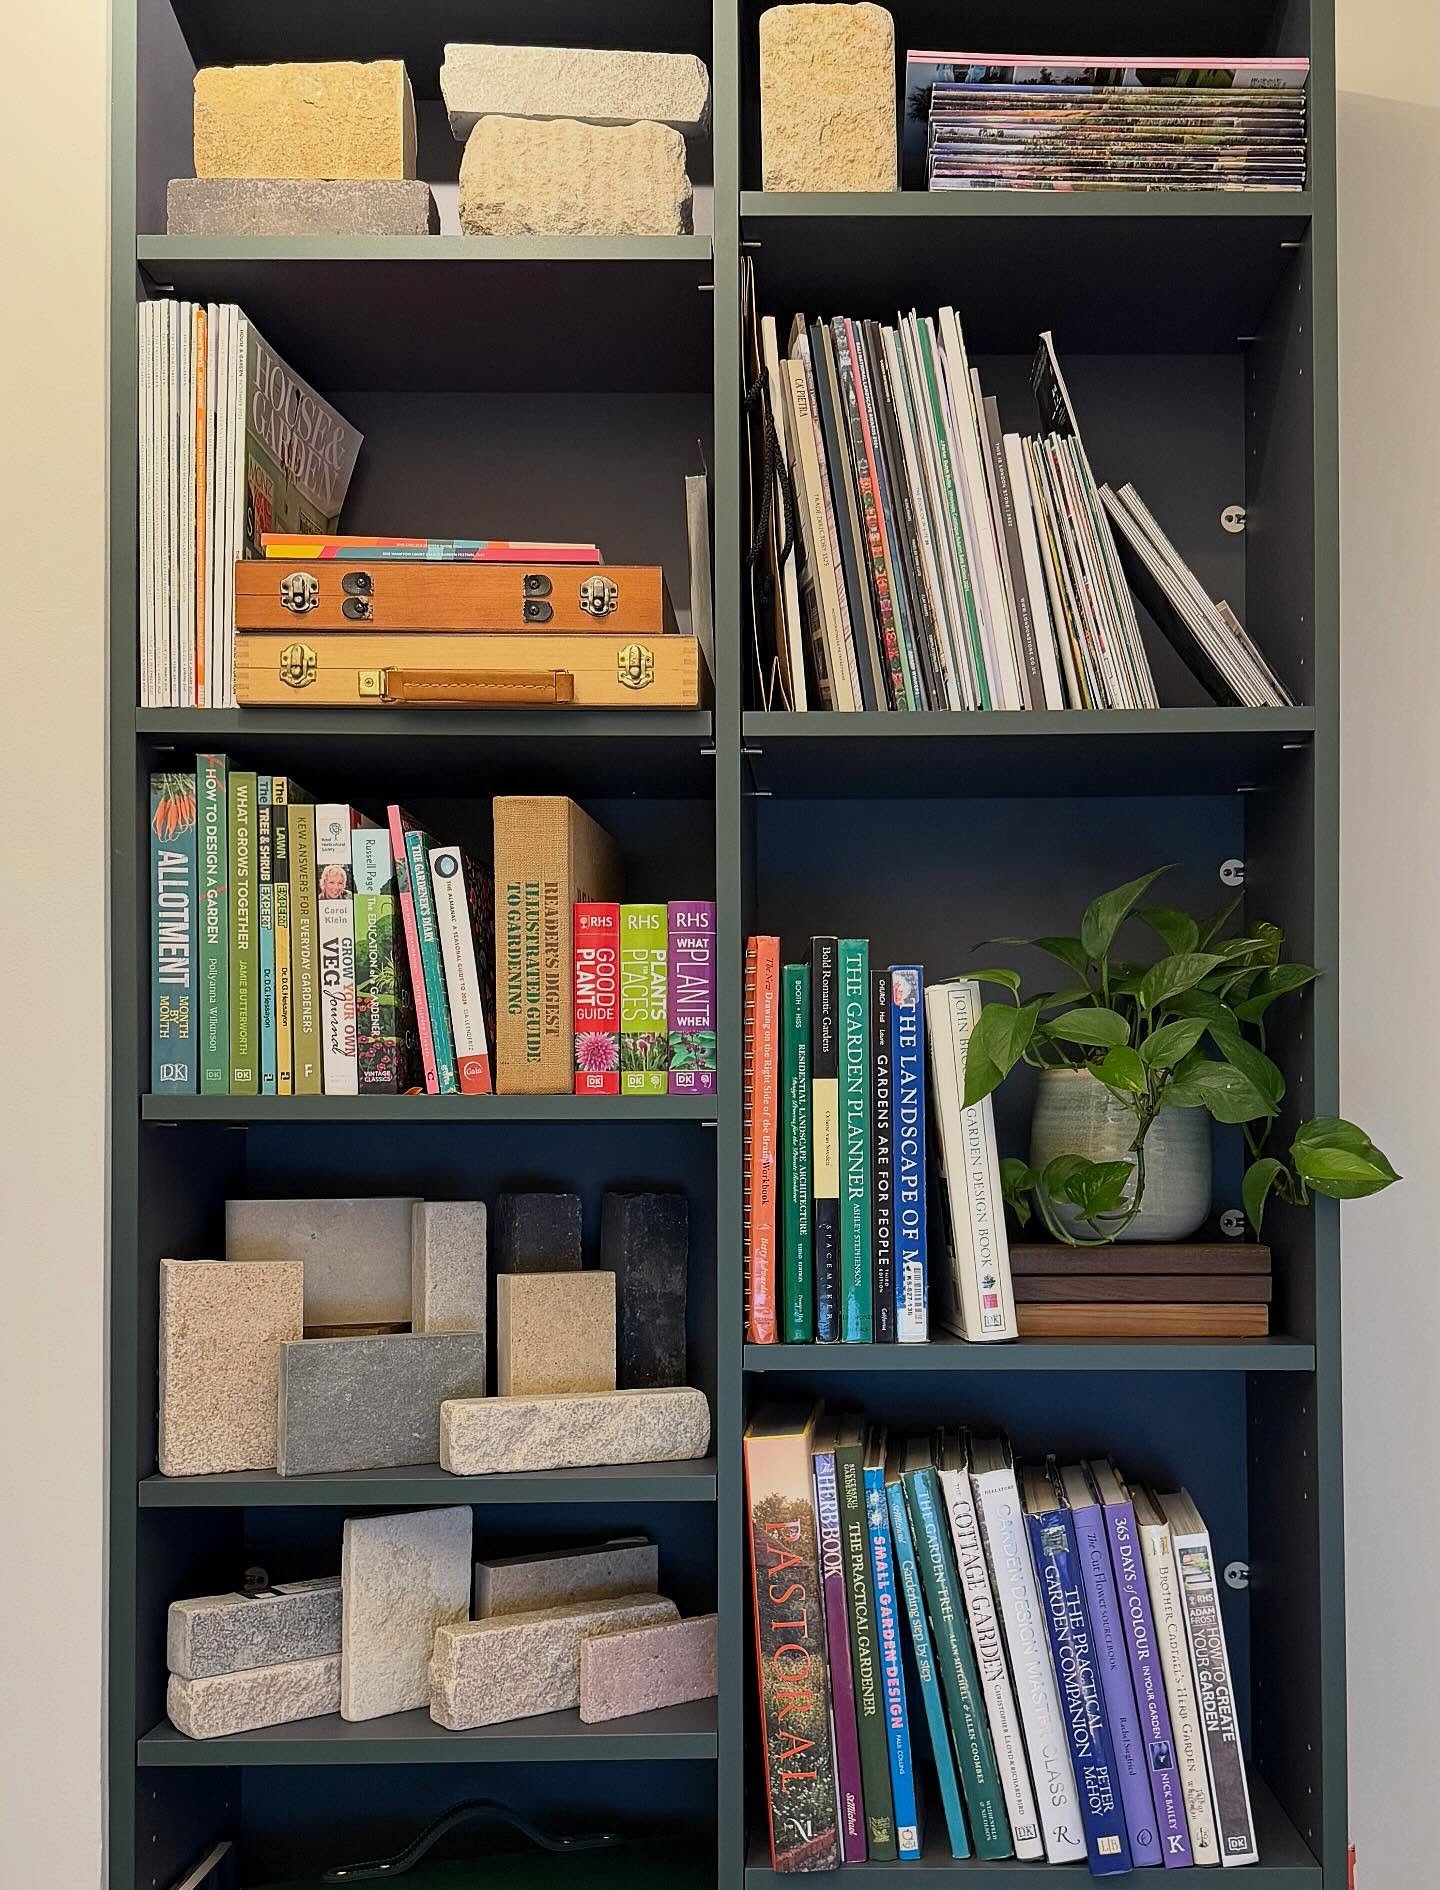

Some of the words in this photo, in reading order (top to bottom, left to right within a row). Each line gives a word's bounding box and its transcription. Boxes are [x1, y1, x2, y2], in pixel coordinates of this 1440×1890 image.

[857, 354, 867, 381] NATIONAL
[255, 340, 331, 451] HOUSE
[796, 390, 808, 418] PIETRA
[860, 382, 872, 413] LANDSCAPE
[867, 414, 876, 436] AWARDS
[253, 390, 339, 504] GARDEN
[813, 494, 822, 515] TRADE
[815, 516, 828, 552] DIRECTORY
[205, 769, 218, 801] HOW
[237, 785, 248, 825] WHAT
[259, 782, 269, 804] The
[275, 781, 284, 804] The
[206, 803, 218, 824] TO
[259, 807, 270, 832] TREE
[297, 817, 307, 840] KEW
[206, 826, 219, 876] DESIGN
[236, 827, 249, 877] GROWS
[259, 842, 270, 881] SHRUB
[276, 827, 287, 859] LAWN
[365, 839, 377, 869] Russell
[411, 845, 422, 863] THE
[207, 877, 218, 887] A
[298, 842, 308, 892] ANSWERS
[365, 871, 376, 891] Page
[260, 886, 272, 930] EXPERT
[277, 884, 288, 929] EXPERT
[299, 894, 309, 915] FOR
[414, 863, 430, 916] GARDENER'S
[447, 893, 456, 923] ALMANAC
[507, 881, 521, 906] TO
[157, 850, 189, 988] ALLOTMENT
[206, 888, 219, 944] GARDEN
[237, 880, 249, 950] TOGETHER
[423, 917, 434, 944] DIARY
[544, 881, 559, 968] READER'S
[590, 916, 613, 927] RHS
[628, 915, 660, 929] RHS
[677, 913, 709, 928] RHS
[299, 918, 312, 969] EVERYDAY
[323, 937, 340, 986] VEG
[341, 937, 353, 978] GROW
[368, 913, 378, 968] EDUCATION
[507, 909, 522, 1015] GARDENING
[525, 881, 540, 1003] ILLUSTRATED
[677, 938, 709, 948] WHAT
[821, 946, 831, 968] Bold
[206, 958, 217, 1003] Pollyanna
[239, 959, 248, 987] JAMIE
[576, 949, 595, 1006] PLANT
[596, 948, 615, 1007] GOOD
[622, 949, 649, 1021] PLACES
[650, 949, 667, 1020] PLANTS
[677, 949, 710, 1016] PLANT
[822, 970, 832, 1015] Romantic
[846, 953, 862, 997] THE
[159, 995, 169, 1039] MONTH
[170, 1010, 179, 1023] BY
[179, 996, 189, 1039] MONTH
[239, 988, 248, 1055] BUTTERWORTH
[302, 972, 313, 1033] GARDENERS
[323, 990, 346, 1055] Journal
[343, 983, 354, 1021] YOUR
[369, 986, 380, 1037] GARDENER
[545, 972, 560, 1037] DIGEST
[576, 1008, 615, 1020] GUIDE
[677, 1016, 710, 1026] WHEN
[763, 992, 773, 1029] Drawing
[899, 998, 917, 1048] THE
[953, 996, 969, 1033] JOHN
[209, 1006, 219, 1052] Wilkinson
[344, 1024, 355, 1057] OWN
[526, 1006, 541, 1063] GUIDE
[822, 1017, 832, 1053] Gardens
[847, 1001, 863, 1093] GARDEN
[762, 1060, 772, 1083] Right
[798, 1044, 806, 1104] RESIDENTIAL
[878, 1054, 889, 1129] GARDENS
[763, 1085, 772, 1105] Side
[798, 1107, 806, 1162] LANDSCAPE
[847, 1100, 864, 1201] PLANNER
[878, 1135, 889, 1165] ARE
[900, 1055, 918, 1203] LANDSCAPE
[966, 1108, 981, 1166] GARDEN
[761, 1162, 770, 1205] Workbook
[799, 1164, 807, 1235] ARCHITECTURE
[878, 1171, 889, 1202] FOR
[972, 1172, 988, 1223] DESIGN
[853, 1203, 861, 1233] ASHLEY
[878, 1208, 889, 1265] PEOPLE
[902, 1209, 918, 1240] OF
[853, 1234, 861, 1287] STEPHENSON
[978, 1228, 993, 1268] BOOK
[818, 1474, 839, 1524] HERB
[918, 1490, 934, 1520] THE
[848, 1521, 863, 1552] THE
[1114, 1517, 1129, 1541] 365
[821, 1525, 842, 1580] BOOK
[873, 1536, 891, 1590] SMALL
[925, 1523, 946, 1583] GARDEN
[1090, 1550, 1102, 1571] Cut
[1119, 1545, 1137, 1582] DAYS
[850, 1554, 869, 1634] PRACTICAL
[901, 1560, 921, 1617] Gardening
[937, 1587, 955, 1623] TREE
[952, 1501, 987, 1591] COTTAGE
[971, 1595, 1005, 1682] GARDEN
[1064, 1585, 1085, 1629] THE
[1094, 1573, 1107, 1609] Flower
[1122, 1584, 1136, 1595] of
[879, 1593, 898, 1662] GARDEN
[911, 1619, 924, 1641] step
[1128, 1596, 1149, 1661] COLOUR
[1189, 1607, 1215, 1617] ADAM
[763, 1518, 817, 1794] PASTORAL
[917, 1643, 929, 1657] by
[997, 1504, 1025, 1580] GARDEN
[1012, 1585, 1038, 1653] DESIGN
[1041, 1744, 1068, 1808] CLASS
[1045, 1566, 1069, 1641] GARDEN
[1059, 1646, 1091, 1757] COMPANION
[1101, 1610, 1117, 1671] SOURCEBOOK
[1193, 1629, 1208, 1667] YOUR
[1206, 1627, 1224, 1660] HOW
[858, 1635, 876, 1717] GARDENER
[920, 1659, 933, 1682] step
[1073, 1633, 1103, 1734] PRACTICAL
[1159, 1566, 1173, 1624] BROTHER
[1181, 1723, 1196, 1772] GARDEN
[1212, 1663, 1226, 1683] TO
[886, 1666, 903, 1729] DESIGN
[1200, 1670, 1219, 1731] GARDEN
[1216, 1686, 1235, 1742] CREATE
[964, 1712, 976, 1740] ALLEN
[1147, 1702, 1161, 1739] GARDEN
[971, 1742, 985, 1784] COOMBES
[1082, 1766, 1103, 1816] McHOY
[1096, 1766, 1114, 1813] PETER
[1160, 1773, 1172, 1798] NICK
[1164, 1799, 1177, 1830] BAILEY
